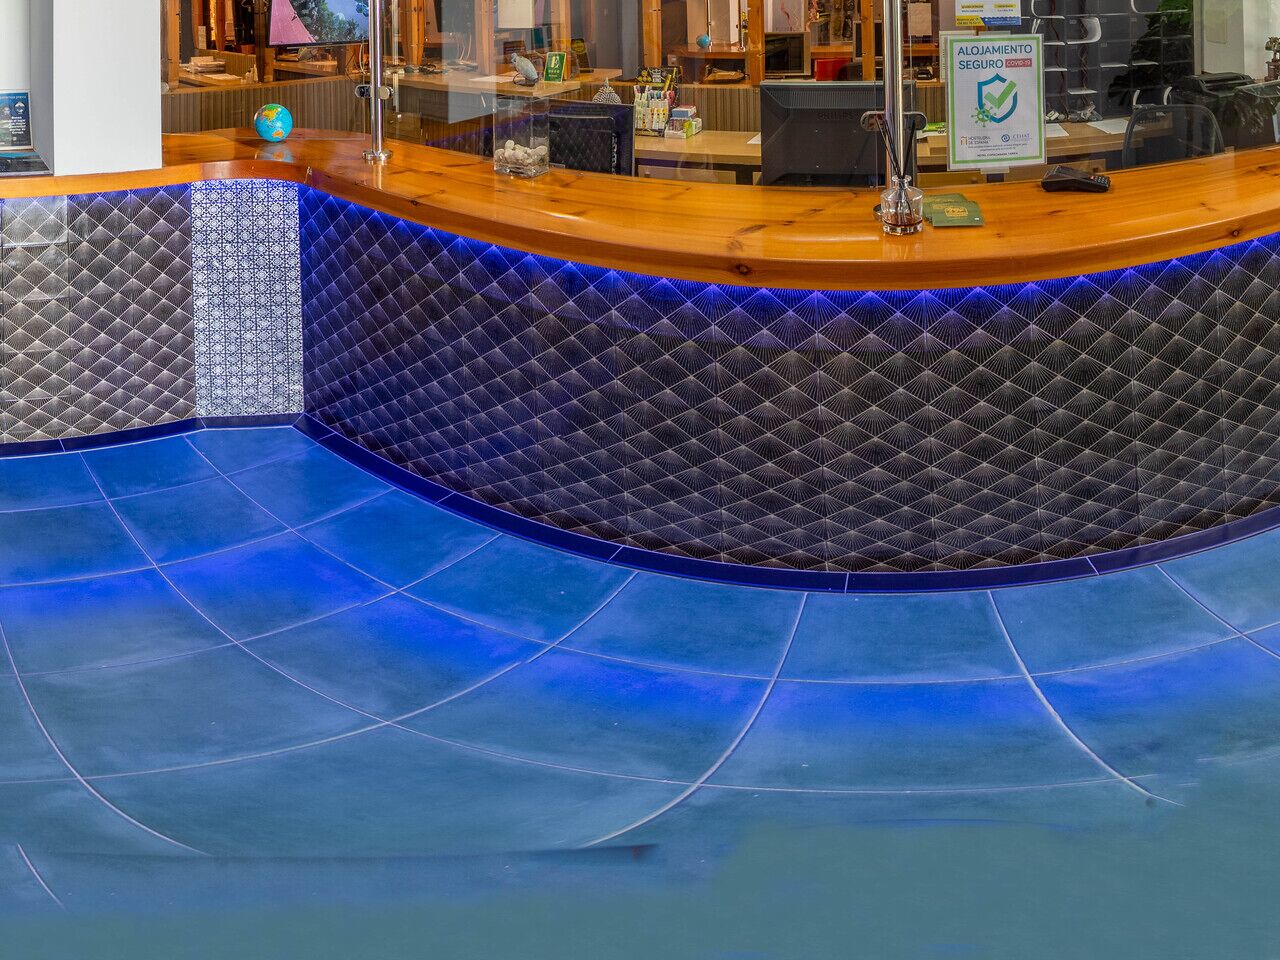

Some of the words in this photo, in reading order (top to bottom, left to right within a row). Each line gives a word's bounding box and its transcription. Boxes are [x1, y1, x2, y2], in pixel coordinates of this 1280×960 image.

[957, 44, 1033, 56] ALOJAMIENTO
[958, 59, 1004, 70] SEGURO
[1006, 59, 1031, 68] COVID-19
